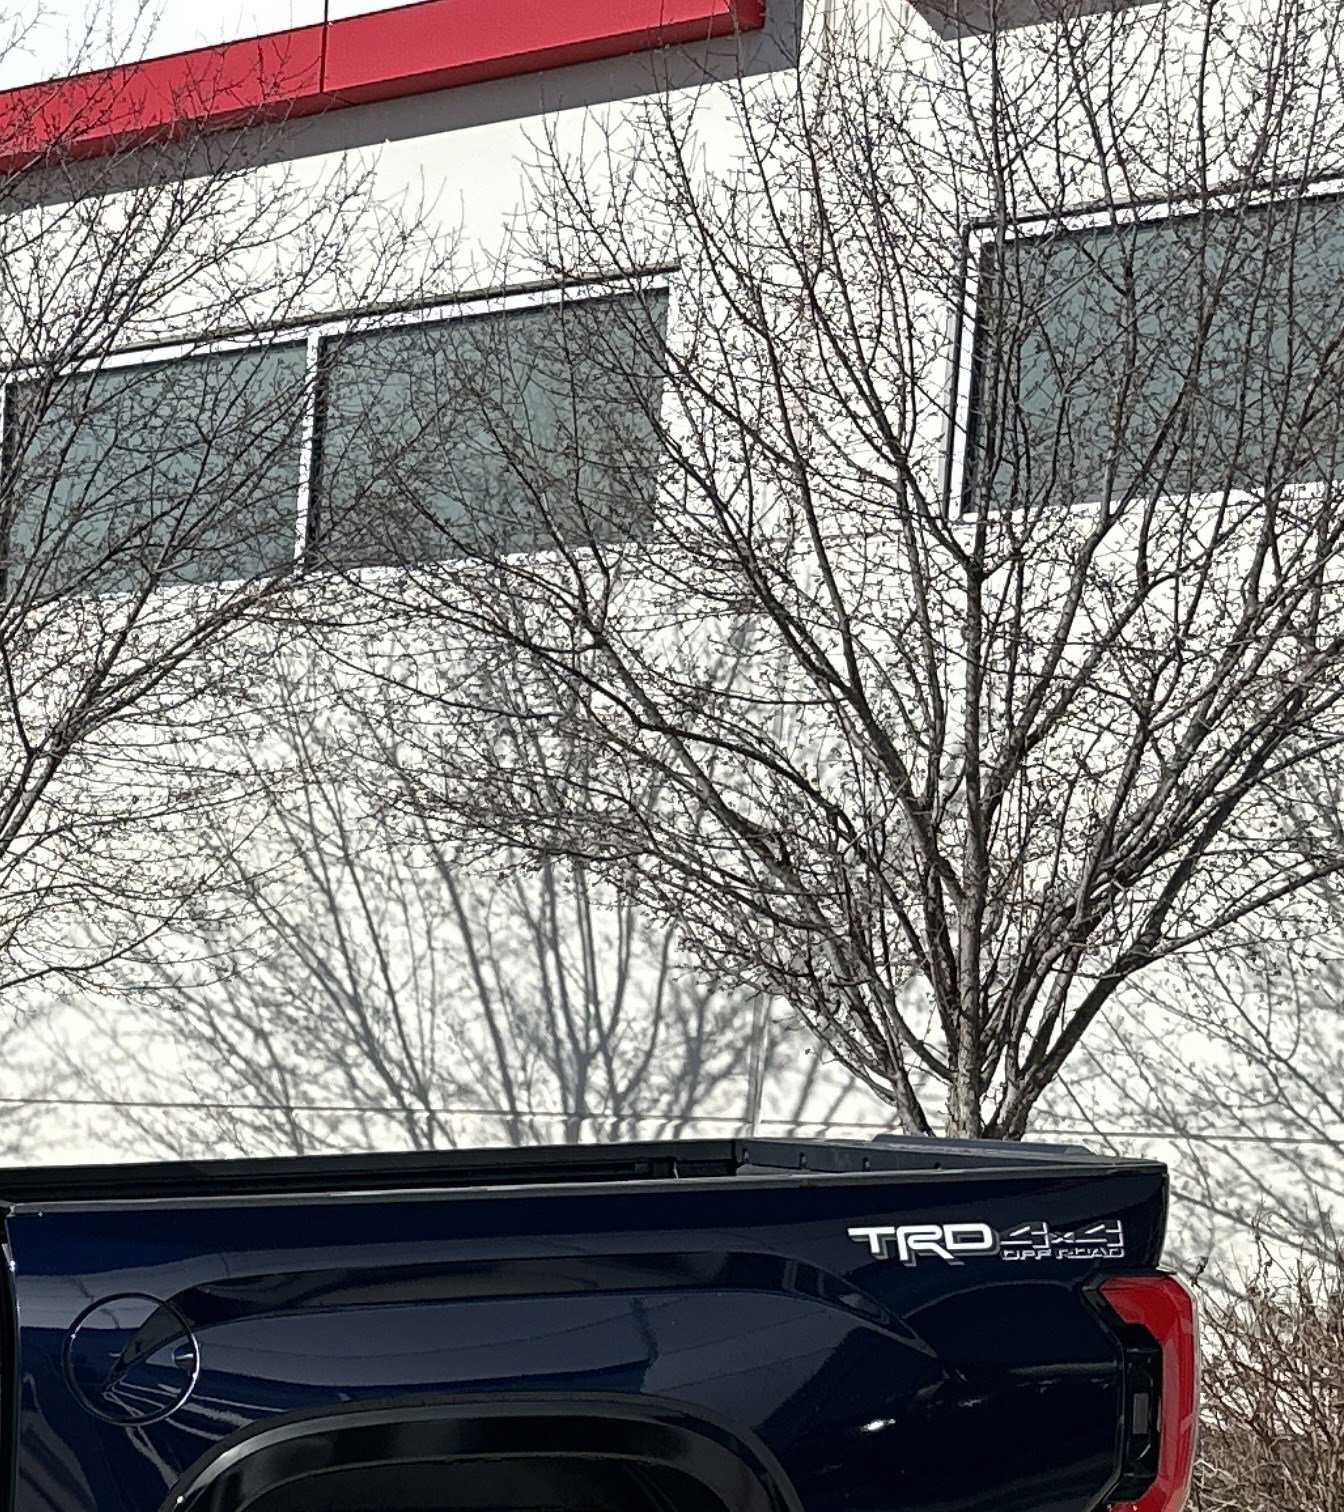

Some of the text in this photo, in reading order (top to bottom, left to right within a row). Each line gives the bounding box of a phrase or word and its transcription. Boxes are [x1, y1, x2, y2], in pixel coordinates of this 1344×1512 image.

[847, 1219, 1126, 1266] TRD 4x4
[1000, 1247, 1053, 1261] OFF
